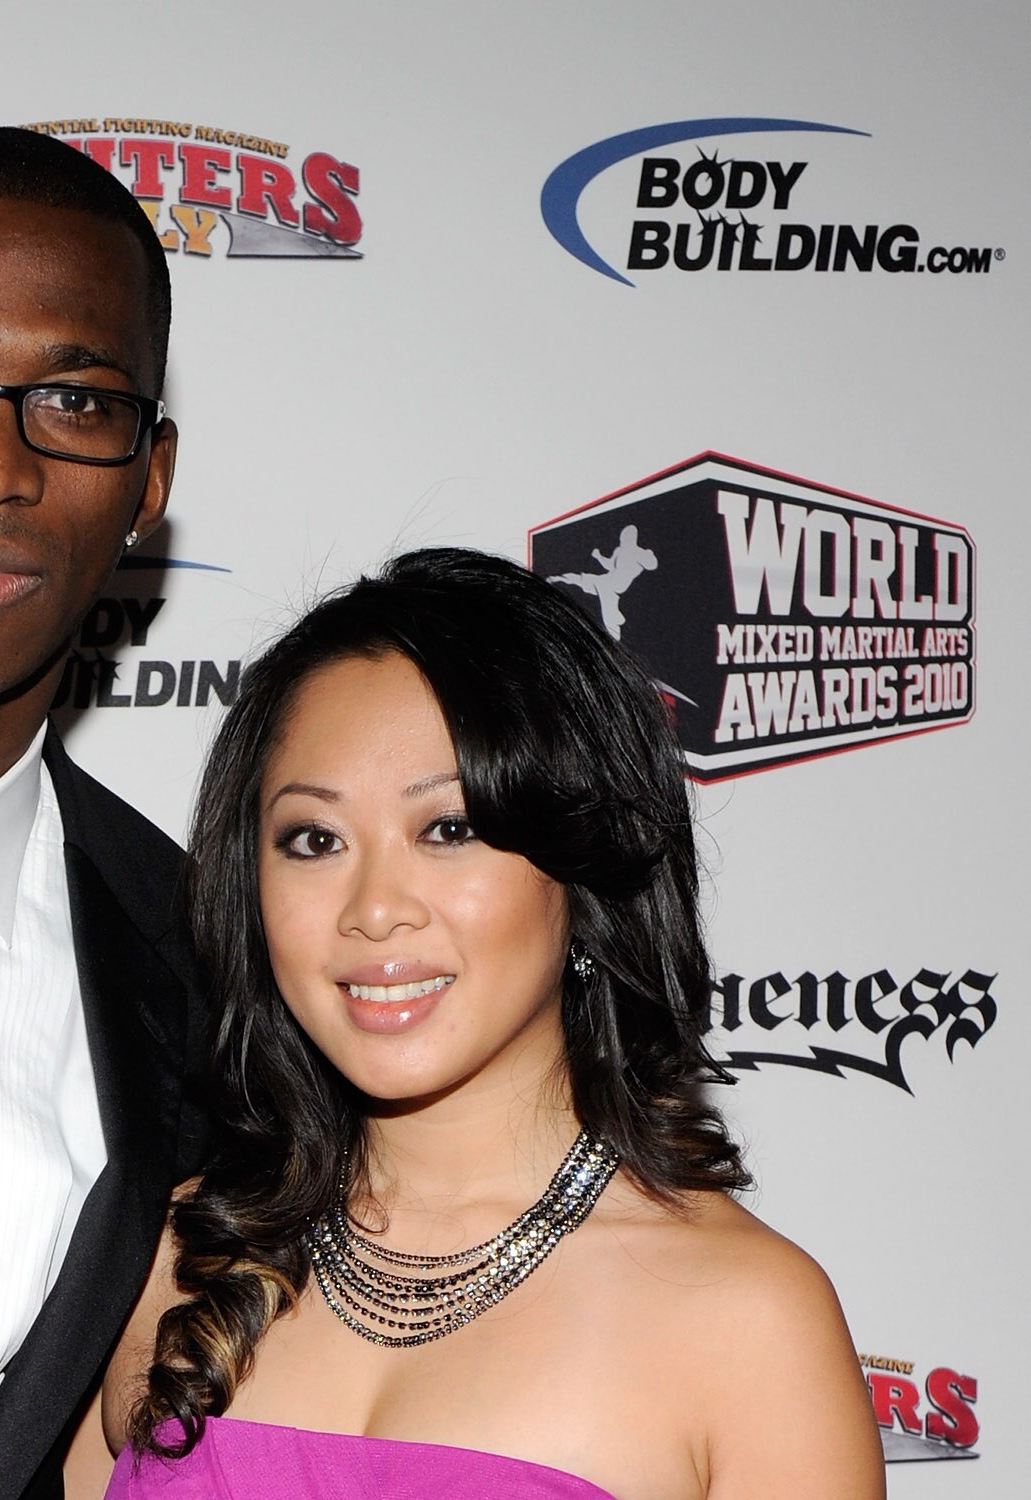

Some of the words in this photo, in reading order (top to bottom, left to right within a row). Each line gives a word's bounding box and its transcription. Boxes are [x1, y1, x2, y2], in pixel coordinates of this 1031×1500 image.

[103, 118, 193, 139] FIGHTING
[196, 126, 289, 159] MAGAZINE
[636, 146, 809, 210] BODY
[717, 490, 969, 621] WORLD
[716, 623, 814, 664] MIXED
[820, 626, 919, 662] MARTIAL
[921, 627, 969, 658] ARTS
[715, 666, 897, 743] AWARDS
[904, 661, 969, 717] 2010
